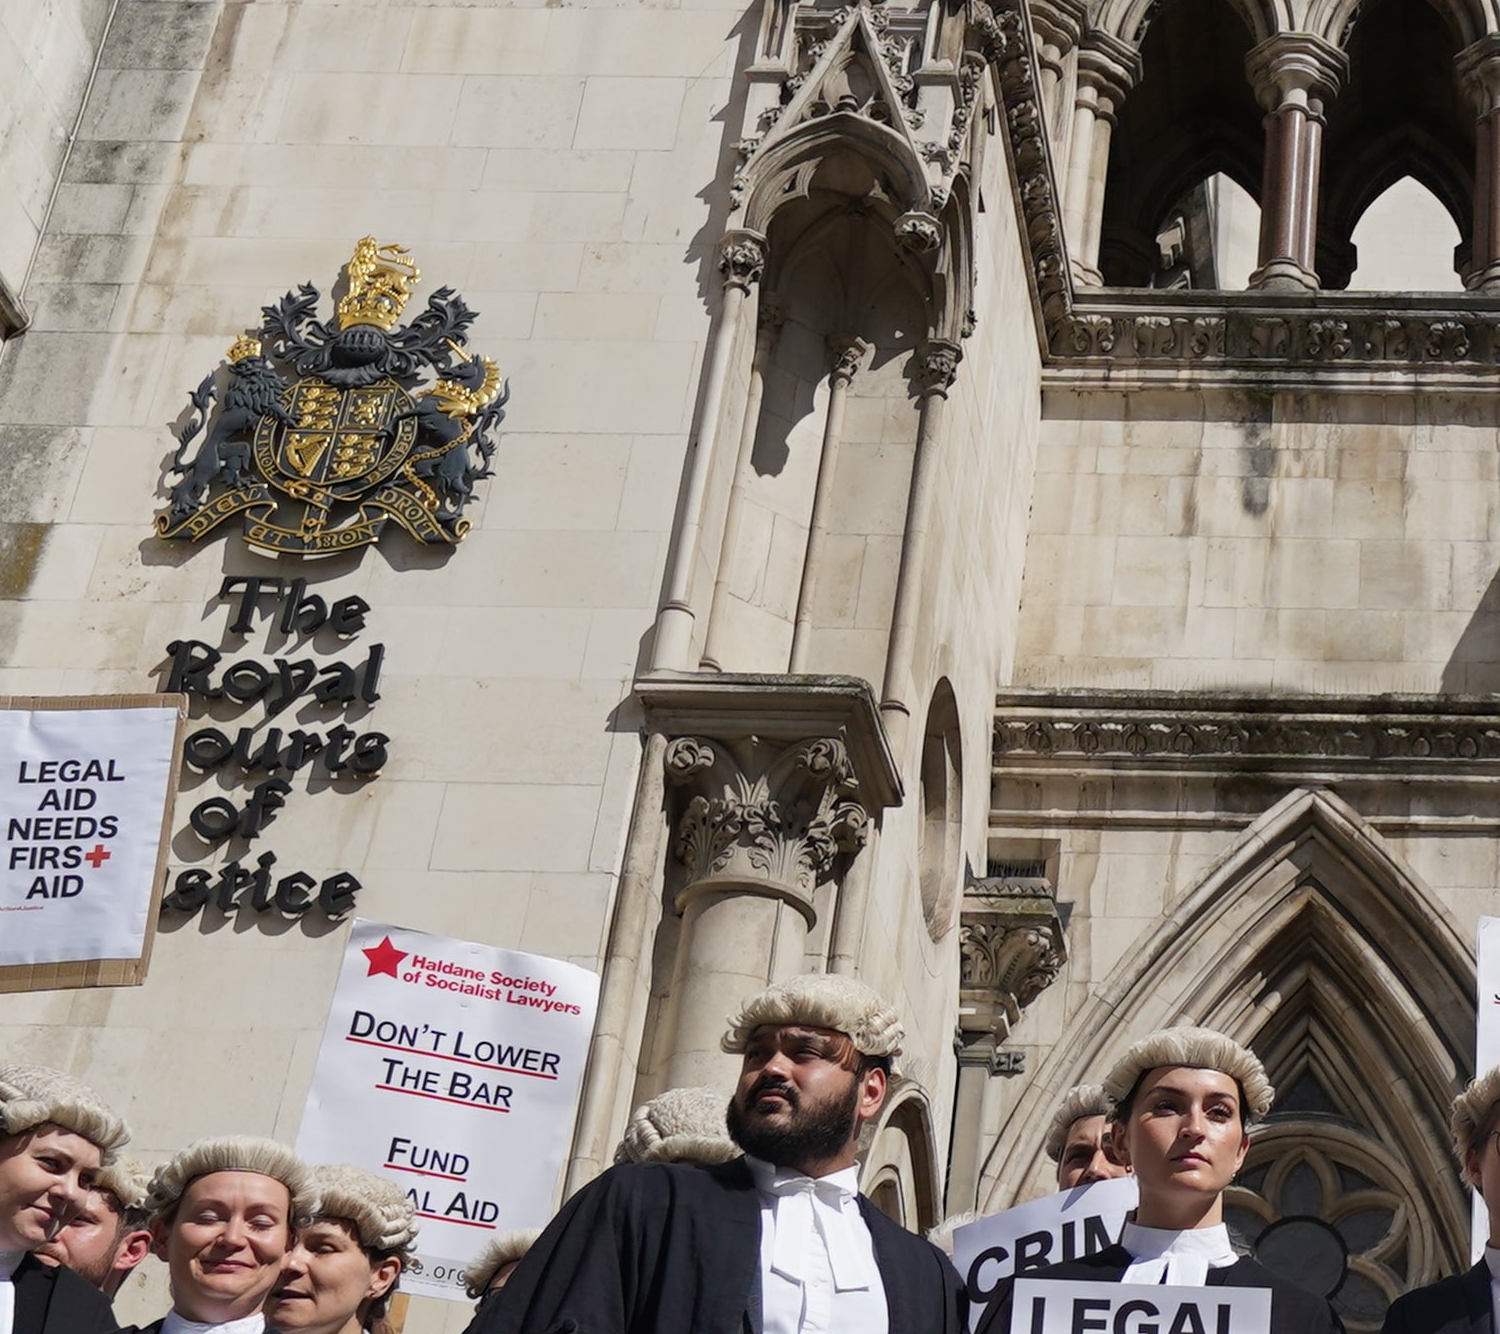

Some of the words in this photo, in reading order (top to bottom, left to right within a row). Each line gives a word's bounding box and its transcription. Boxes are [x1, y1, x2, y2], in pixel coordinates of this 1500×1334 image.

[219, 576, 371, 635] The
[166, 639, 386, 716] Royal
[183, 724, 391, 772] ourts
[18, 759, 127, 784] LEGAL
[36, 787, 97, 812] AID
[190, 778, 293, 839] of
[6, 815, 119, 841] NEEDS
[26, 874, 85, 900] AID
[161, 851, 363, 915] stice
[402, 971, 422, 983] of
[425, 973, 503, 1001] Socialist
[506, 990, 582, 1016] Lawyers
[411, 955, 486, 981] Haldane
[490, 971, 557, 997] Society
[452, 1031, 561, 1075] LOWER
[382, 1057, 442, 1094] THE
[448, 1072, 514, 1108] BAR
[387, 1136, 470, 1176] FUND
[444, 1191, 500, 1224] AID
